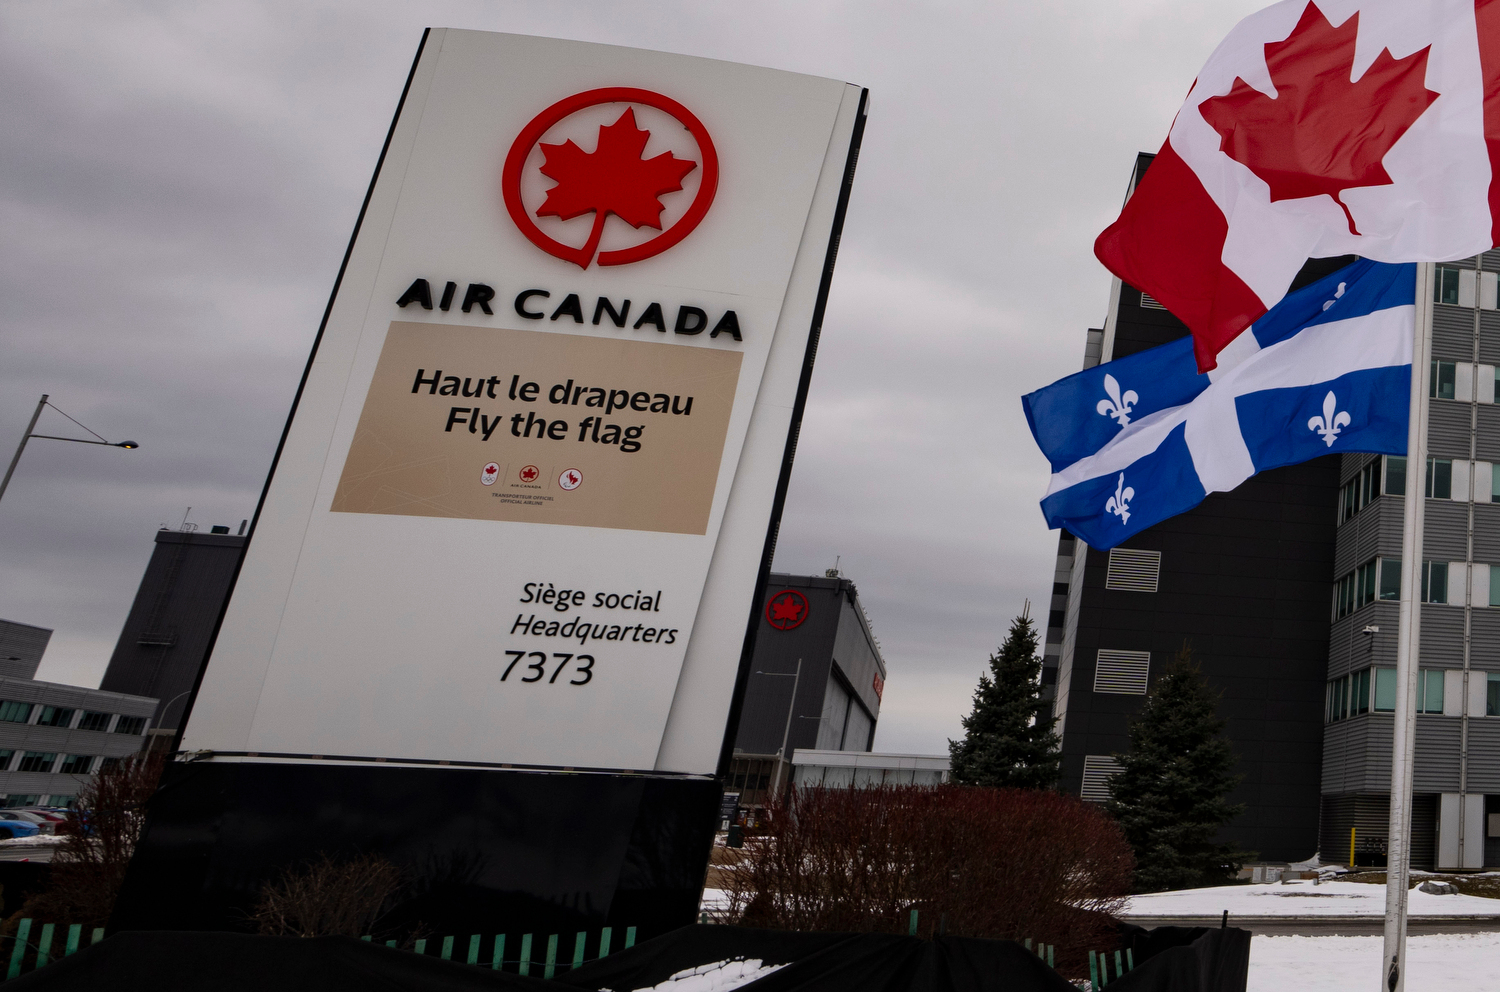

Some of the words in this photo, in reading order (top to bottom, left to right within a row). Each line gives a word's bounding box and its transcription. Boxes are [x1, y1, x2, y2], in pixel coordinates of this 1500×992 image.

[396, 278, 495, 316] AIR
[514, 289, 743, 342] CANADA
[411, 369, 501, 400] Haut
[508, 375, 540, 403] le
[548, 379, 694, 416] drapeau
[444, 407, 503, 442] Fly
[510, 411, 569, 441] the
[577, 416, 646, 453] flag
[519, 582, 586, 613] Siège
[592, 590, 662, 613] social
[510, 614, 679, 646] Headquarters
[500, 650, 595, 686] 7373
